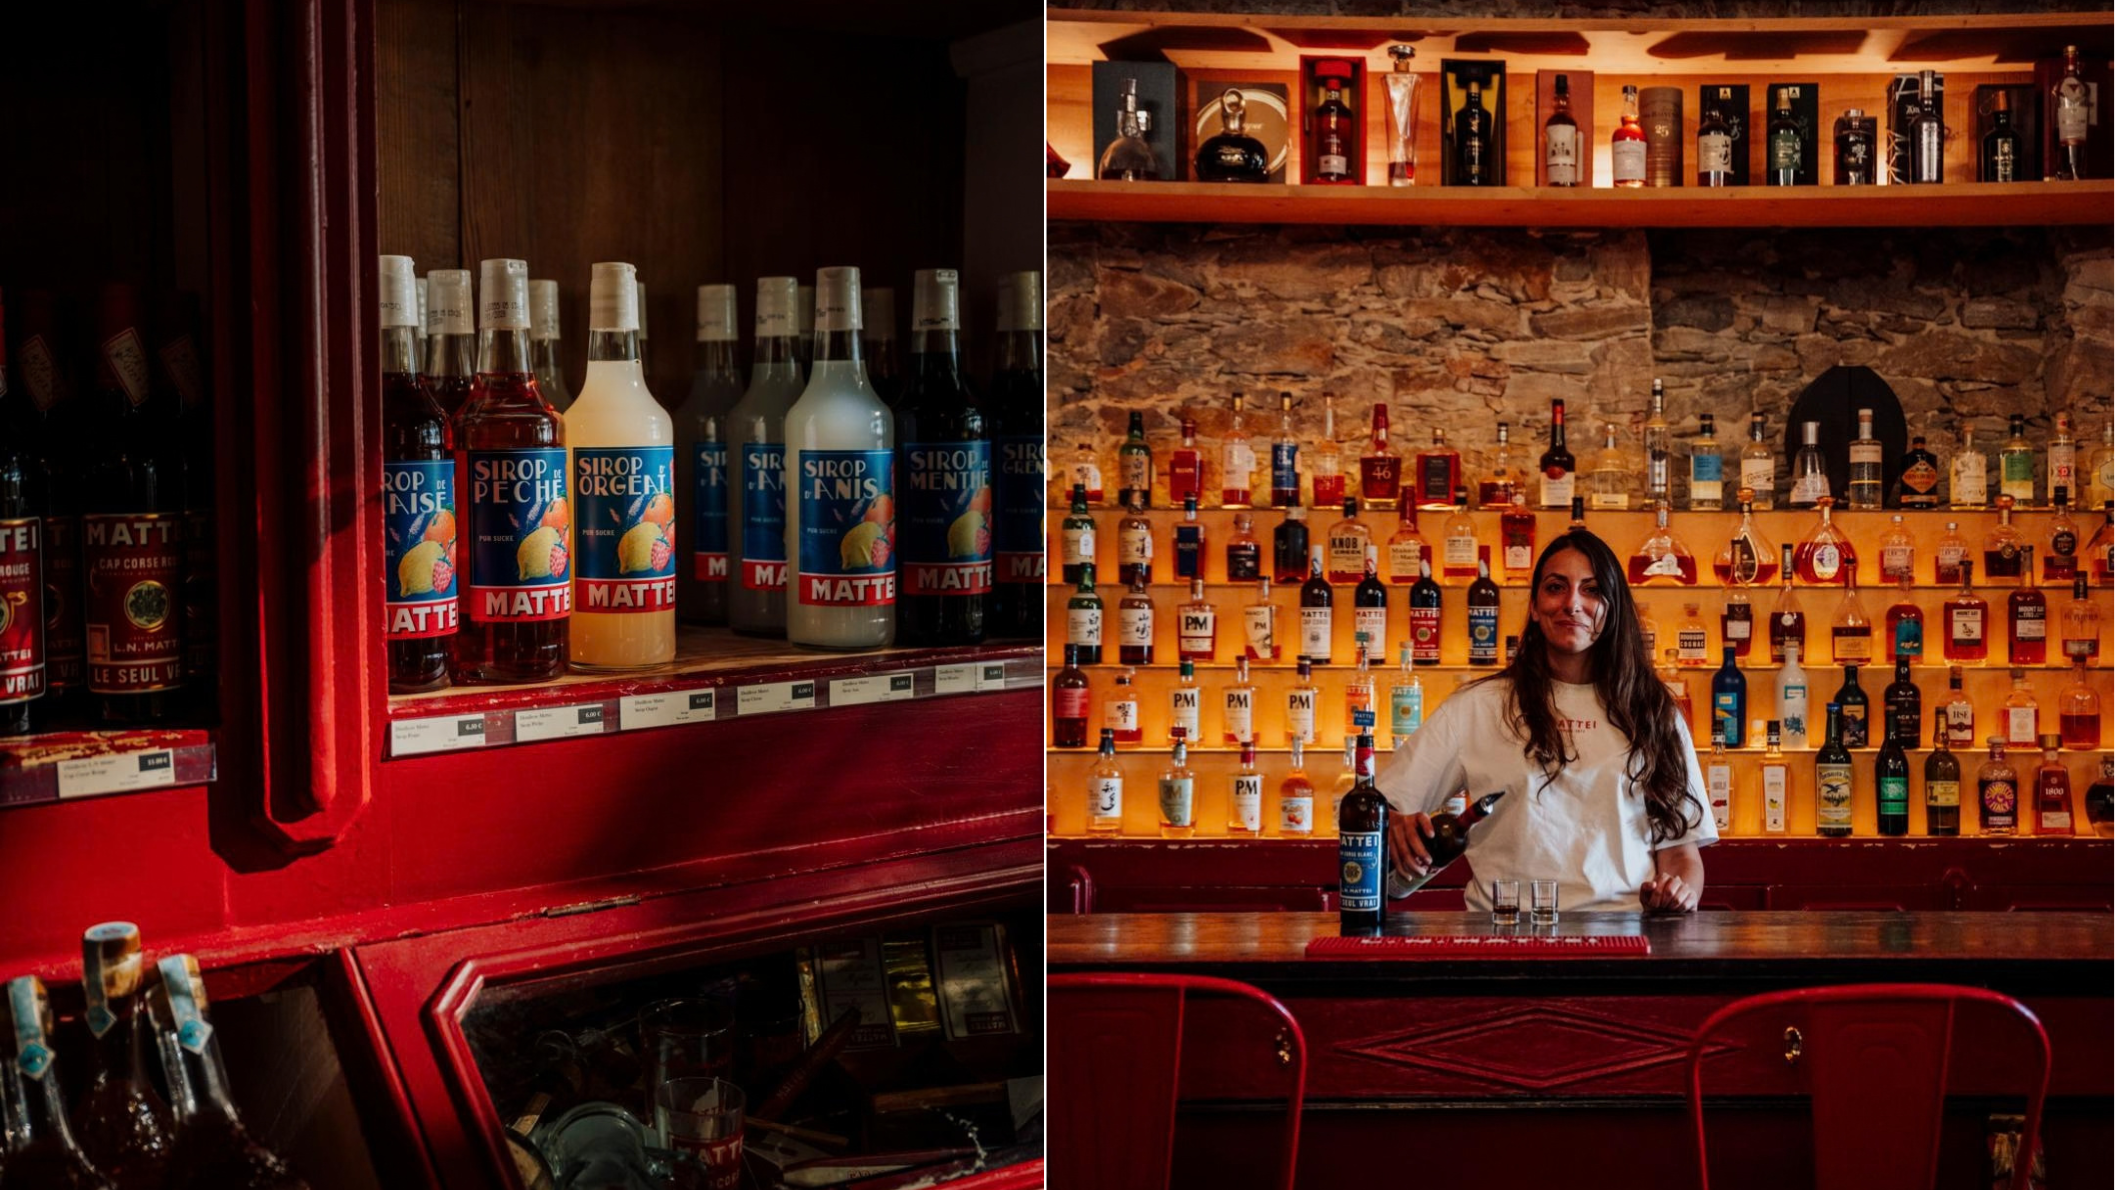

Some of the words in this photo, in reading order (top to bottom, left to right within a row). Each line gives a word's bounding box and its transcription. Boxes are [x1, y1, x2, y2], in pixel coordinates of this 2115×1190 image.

[1655, 124, 1669, 138] 25
[748, 452, 786, 470] SIR
[910, 450, 979, 471] SIROP
[1002, 443, 1044, 461] SIR
[474, 459, 547, 481] SIROP
[553, 468, 562, 479] DE
[578, 456, 643, 476] SIROP
[804, 459, 866, 478] SIROP
[1372, 466, 1392, 480] 46
[384, 471, 425, 492] ROP
[436, 480, 446, 490] DE
[578, 473, 665, 497] ORGEAT
[814, 478, 879, 500] ANIS
[910, 470, 989, 490] MENTHE
[389, 491, 447, 515] AISE
[0, 525, 37, 553] TEI
[1331, 537, 1358, 548] KNOB
[99, 558, 120, 570] CAP
[123, 556, 159, 570] CORSE
[917, 565, 992, 590] MATTE
[588, 581, 675, 609] MATTE
[811, 577, 895, 601] MATTE
[485, 586, 570, 619] MATTE
[386, 604, 458, 633] ATTE
[144, 639, 180, 653] MATT
[5, 672, 40, 694] VRAI
[94, 668, 110, 684] LE
[118, 667, 160, 684] SEUL
[1557, 720, 1597, 729] ATTEI
[1953, 711, 1968, 719] HSE
[2045, 787, 2064, 796] 1800
[1340, 835, 1378, 847] ATTEI
[1358, 898, 1376, 908] VRAI
